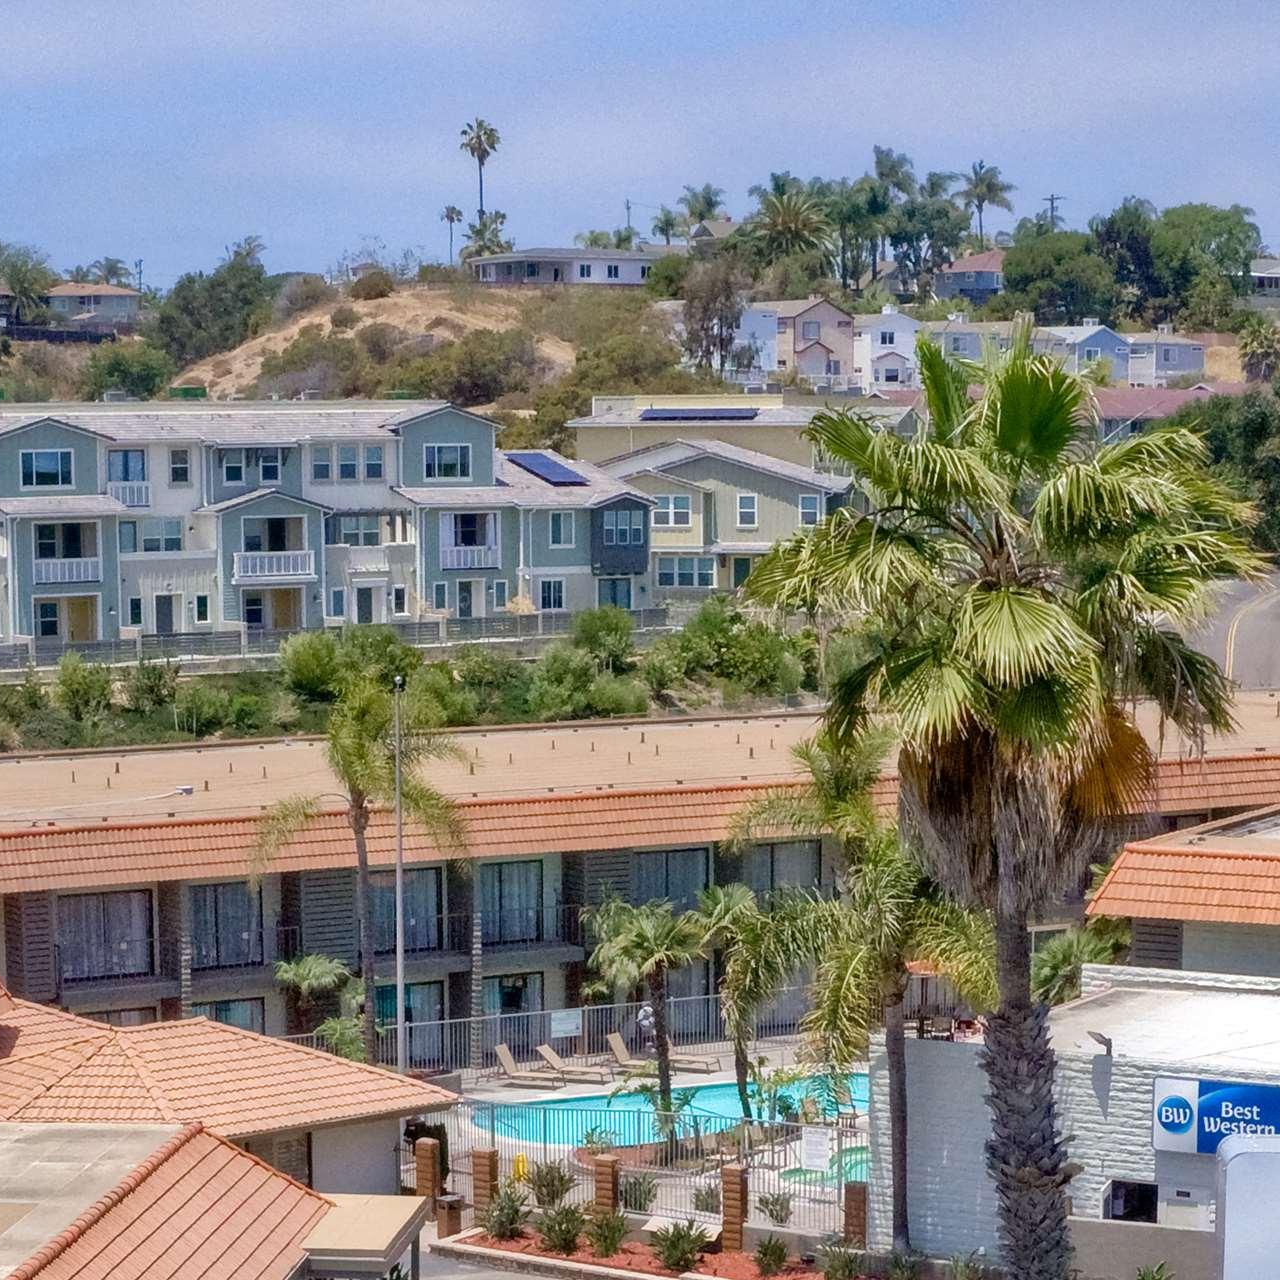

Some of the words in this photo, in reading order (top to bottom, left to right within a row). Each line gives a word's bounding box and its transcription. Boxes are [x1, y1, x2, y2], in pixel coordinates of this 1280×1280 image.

[1161, 1106, 1190, 1124] BW
[1221, 1102, 1260, 1119] Best
[1203, 1117, 1276, 1135] Western
